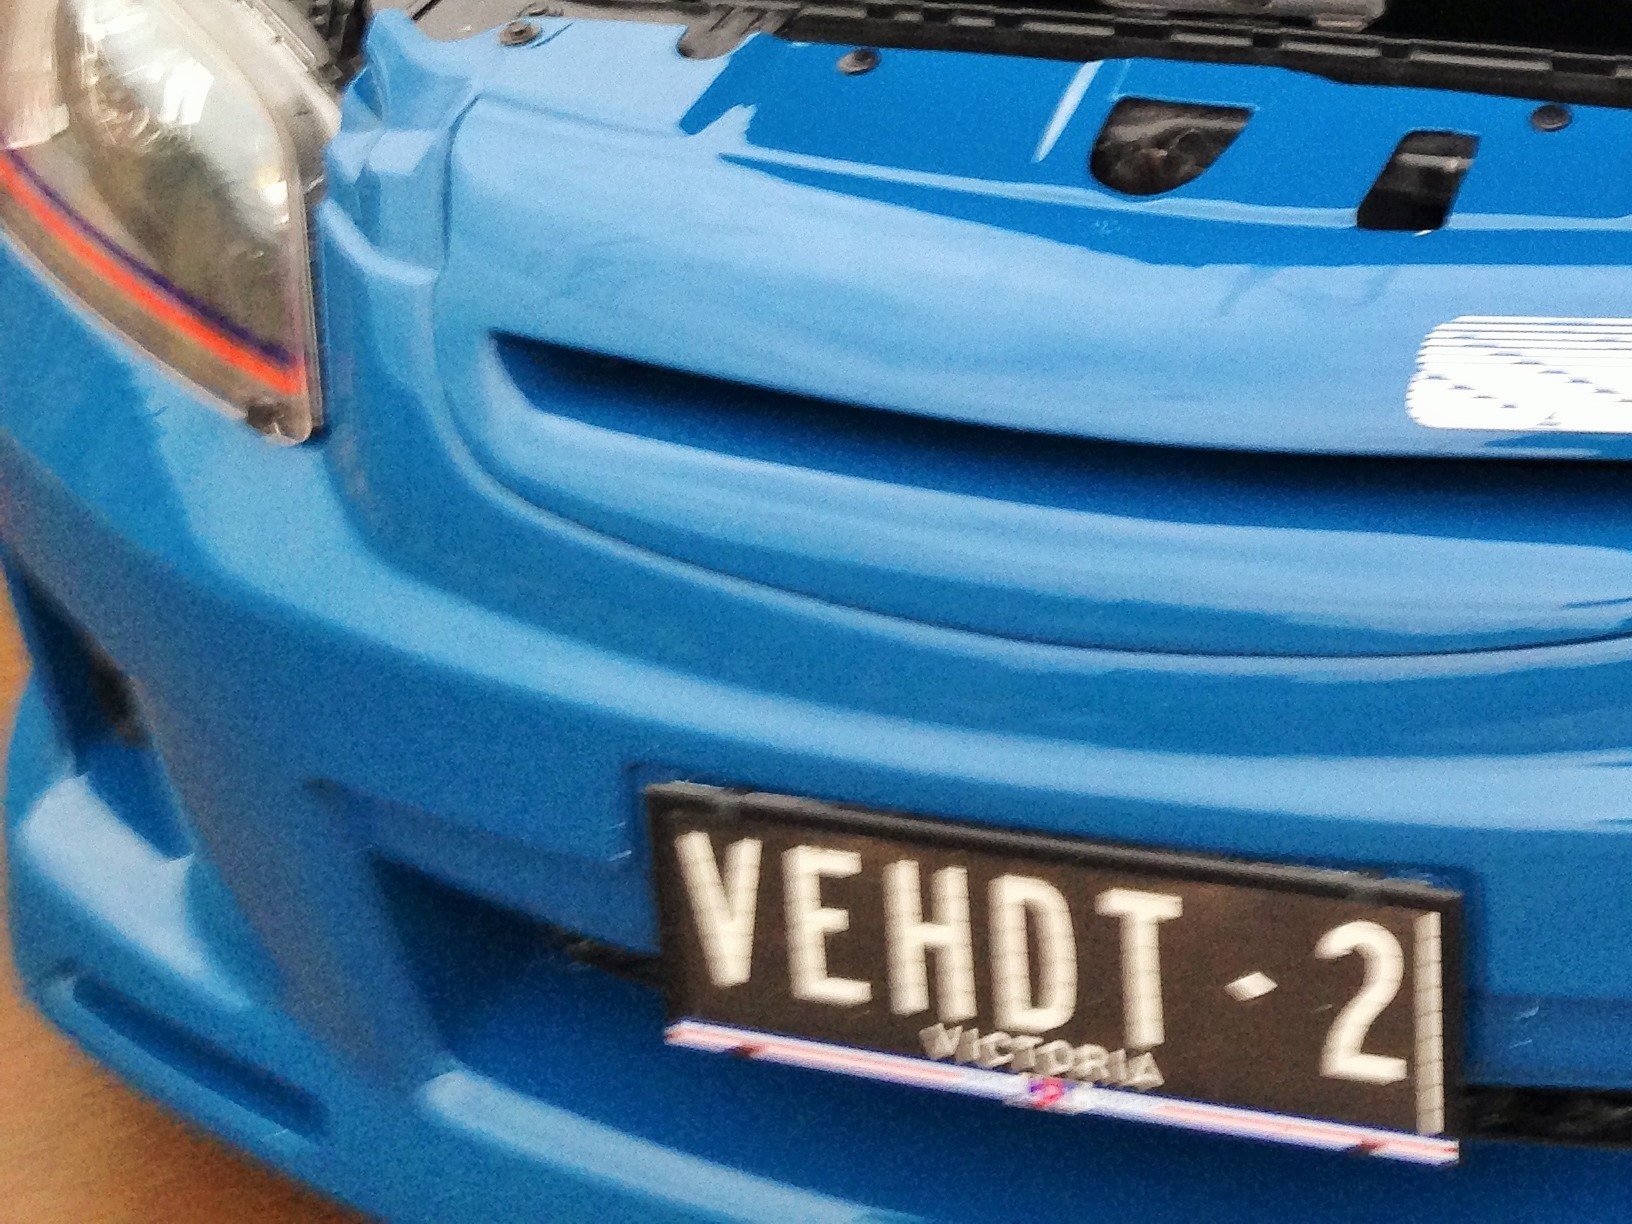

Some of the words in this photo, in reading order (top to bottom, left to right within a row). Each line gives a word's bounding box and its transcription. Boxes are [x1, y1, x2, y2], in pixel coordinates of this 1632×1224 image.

[674, 829, 1183, 1049] VEHDT
[1315, 919, 1407, 1084] 2
[918, 1021, 1166, 1091] VICTORIA
